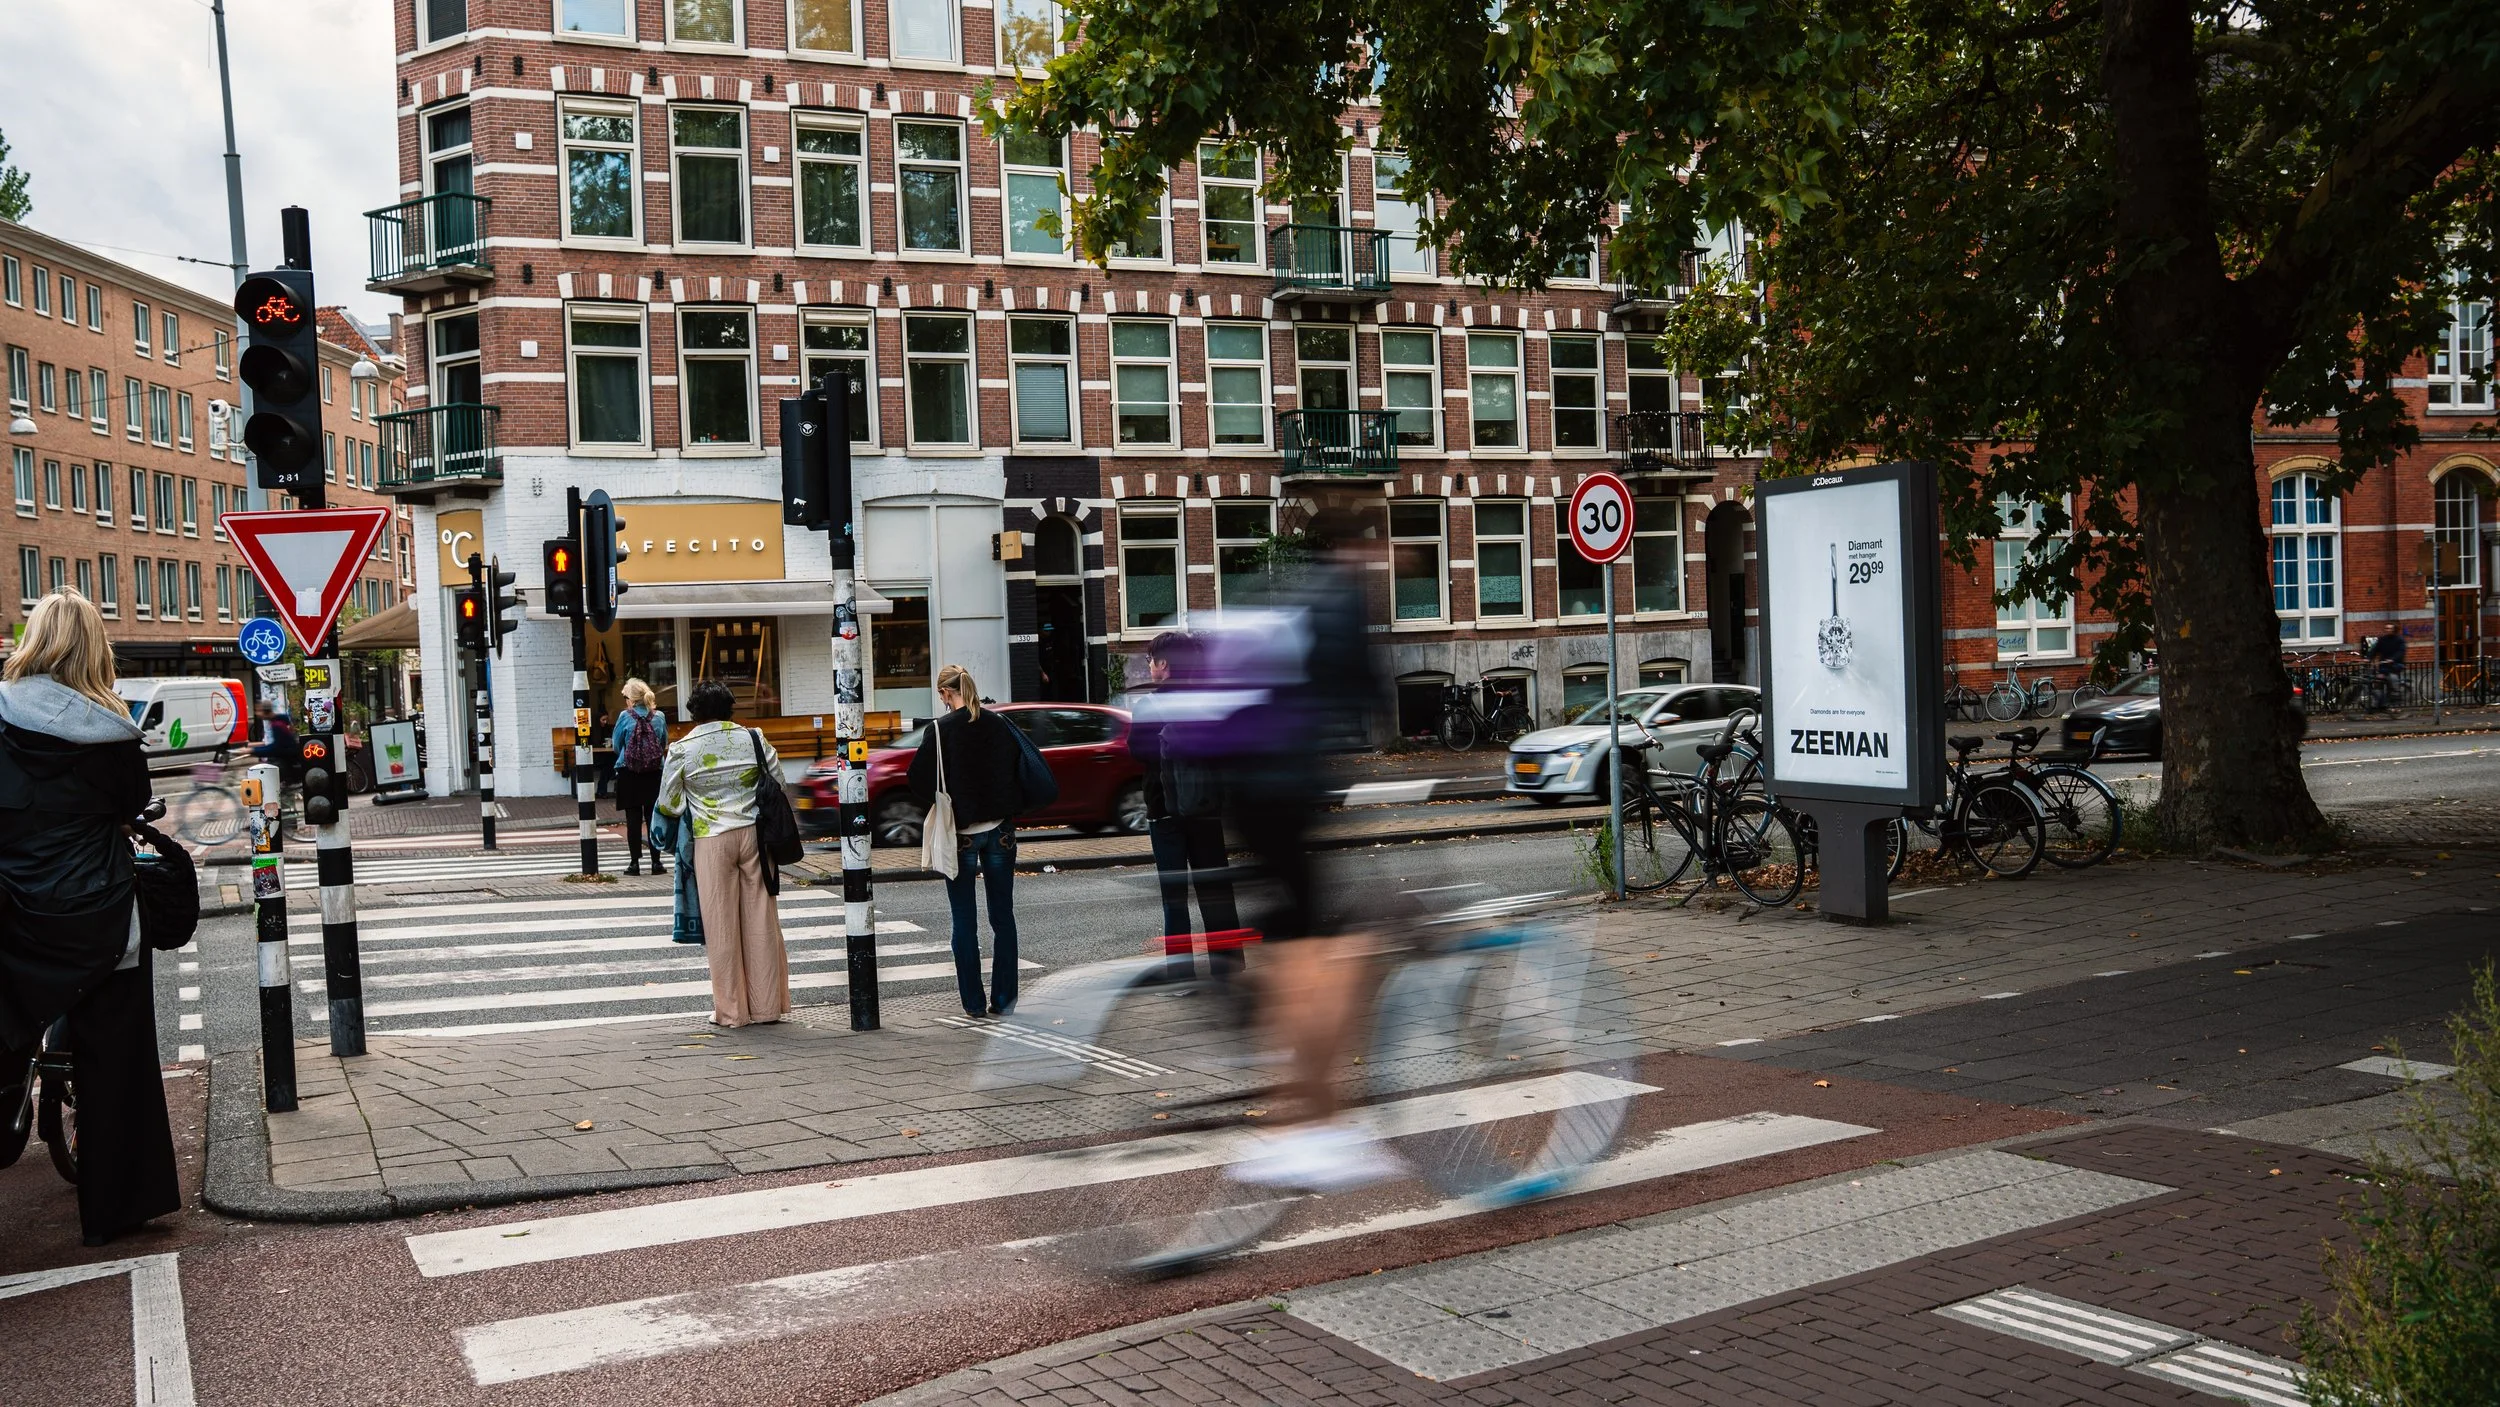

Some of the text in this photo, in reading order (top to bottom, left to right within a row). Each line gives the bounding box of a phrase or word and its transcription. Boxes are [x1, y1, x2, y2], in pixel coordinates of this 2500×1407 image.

[278, 473, 299, 483] 281
[1812, 476, 1843, 487] JCDecaux
[1582, 500, 1621, 535] 30
[619, 538, 765, 553] AFECITO
[1848, 539, 1883, 551] Diamant
[1859, 552, 1877, 560] hanger
[1791, 729, 1889, 758] ZEEMAN
